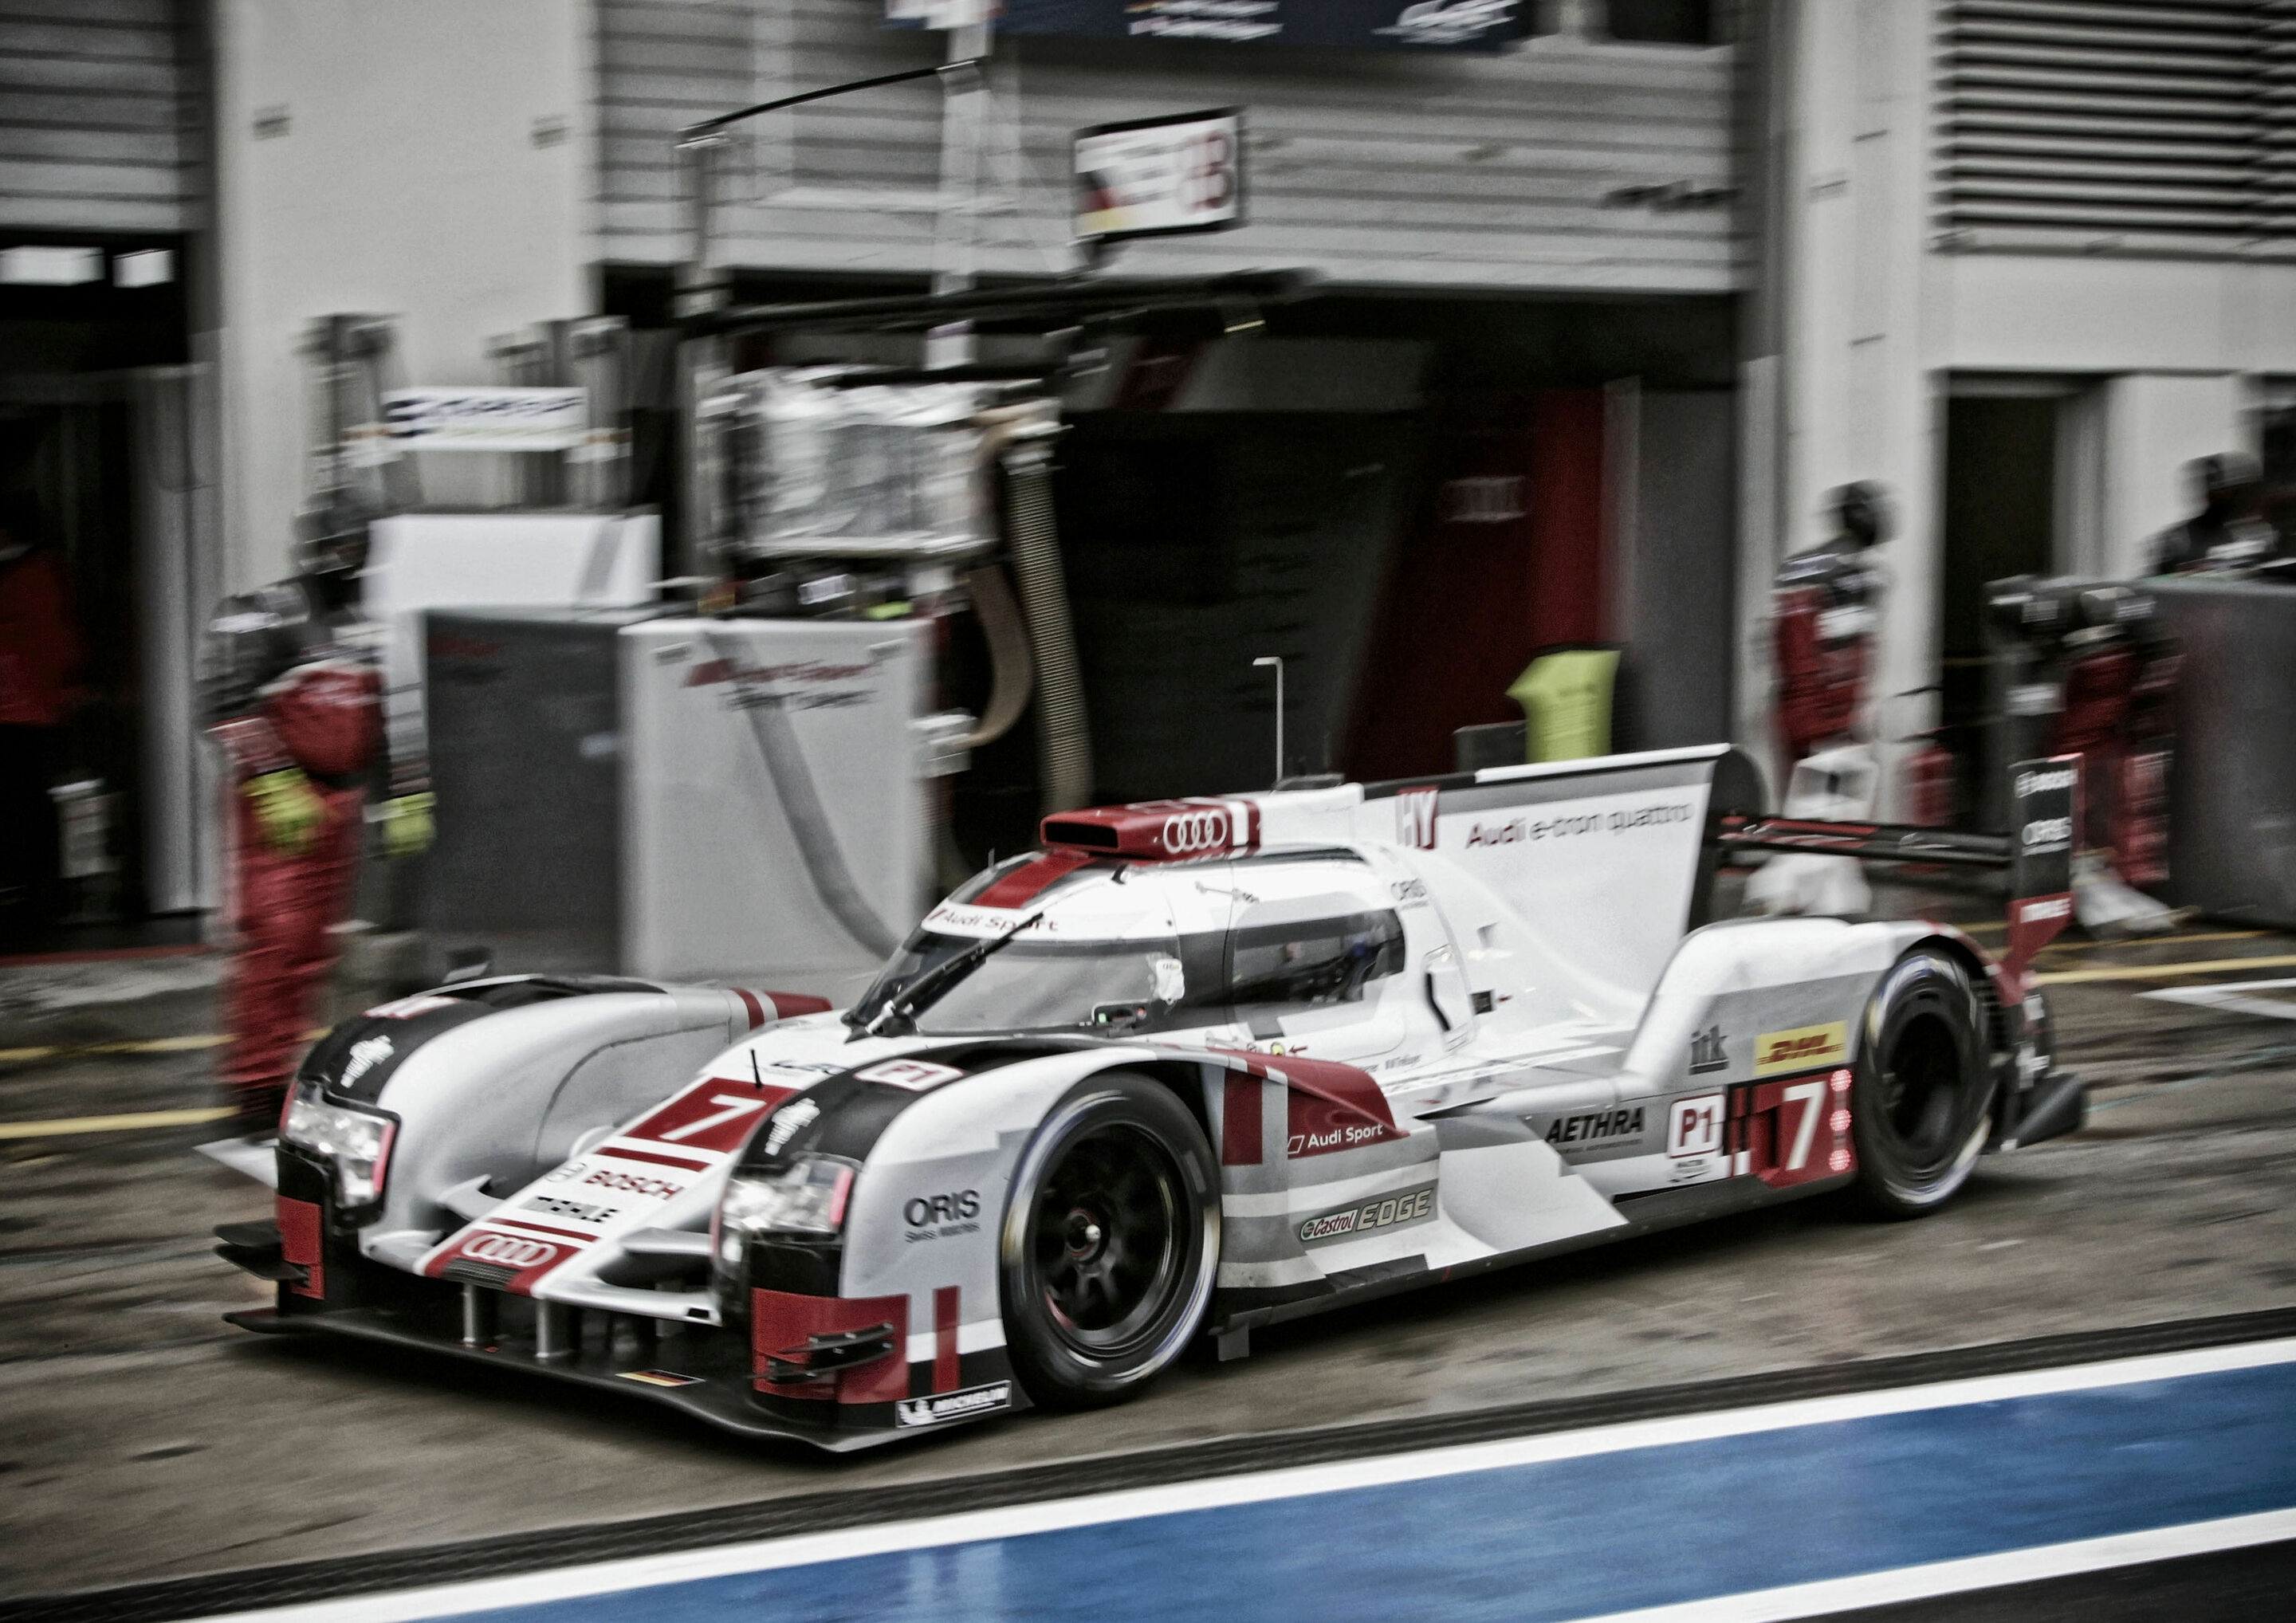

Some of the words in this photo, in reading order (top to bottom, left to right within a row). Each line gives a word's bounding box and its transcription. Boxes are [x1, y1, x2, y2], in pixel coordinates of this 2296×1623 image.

[1465, 817, 1526, 849] Audi
[1529, 812, 1603, 840] e-tron
[1606, 804, 1692, 835] quattro
[659, 1094, 767, 1141] 7
[1307, 1129, 1342, 1148] Audi
[1346, 1123, 1383, 1143] Sport
[1544, 1106, 1645, 1143] AETHRA
[1679, 1106, 1712, 1146] P1
[1783, 1081, 1826, 1171] 7
[584, 1169, 684, 1201] BOSCH
[903, 1189, 981, 1228] ORIS
[1313, 1211, 1354, 1236] Castrol
[1356, 1188, 1433, 1231] EDGE
